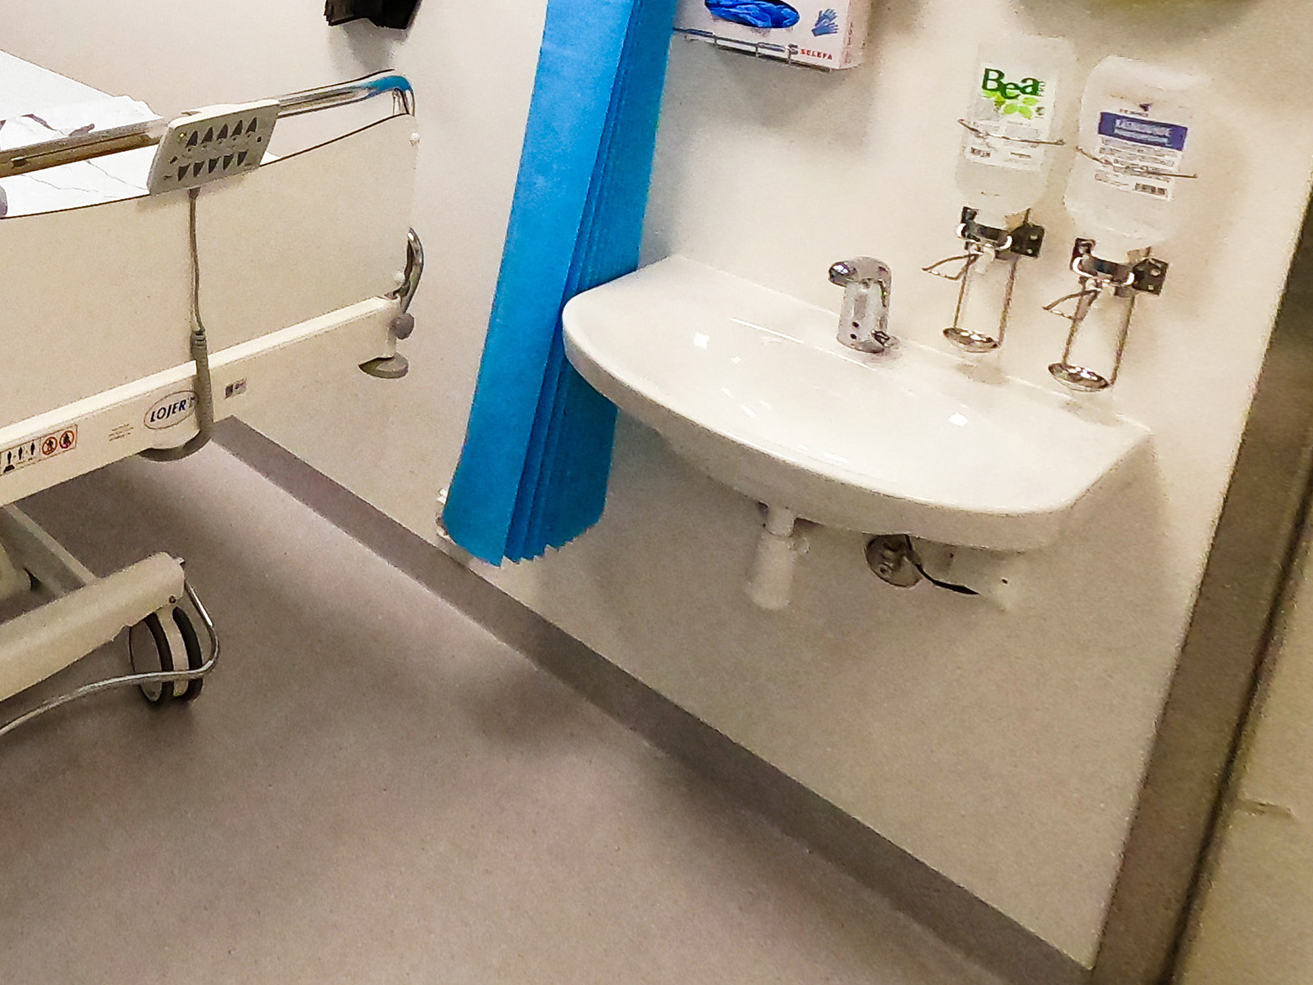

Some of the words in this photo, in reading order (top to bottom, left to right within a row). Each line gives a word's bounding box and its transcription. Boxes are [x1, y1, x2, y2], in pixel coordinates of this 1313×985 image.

[800, 49, 833, 60] SELEFA
[982, 68, 1040, 99] Bea
[150, 399, 187, 423] LOJER
